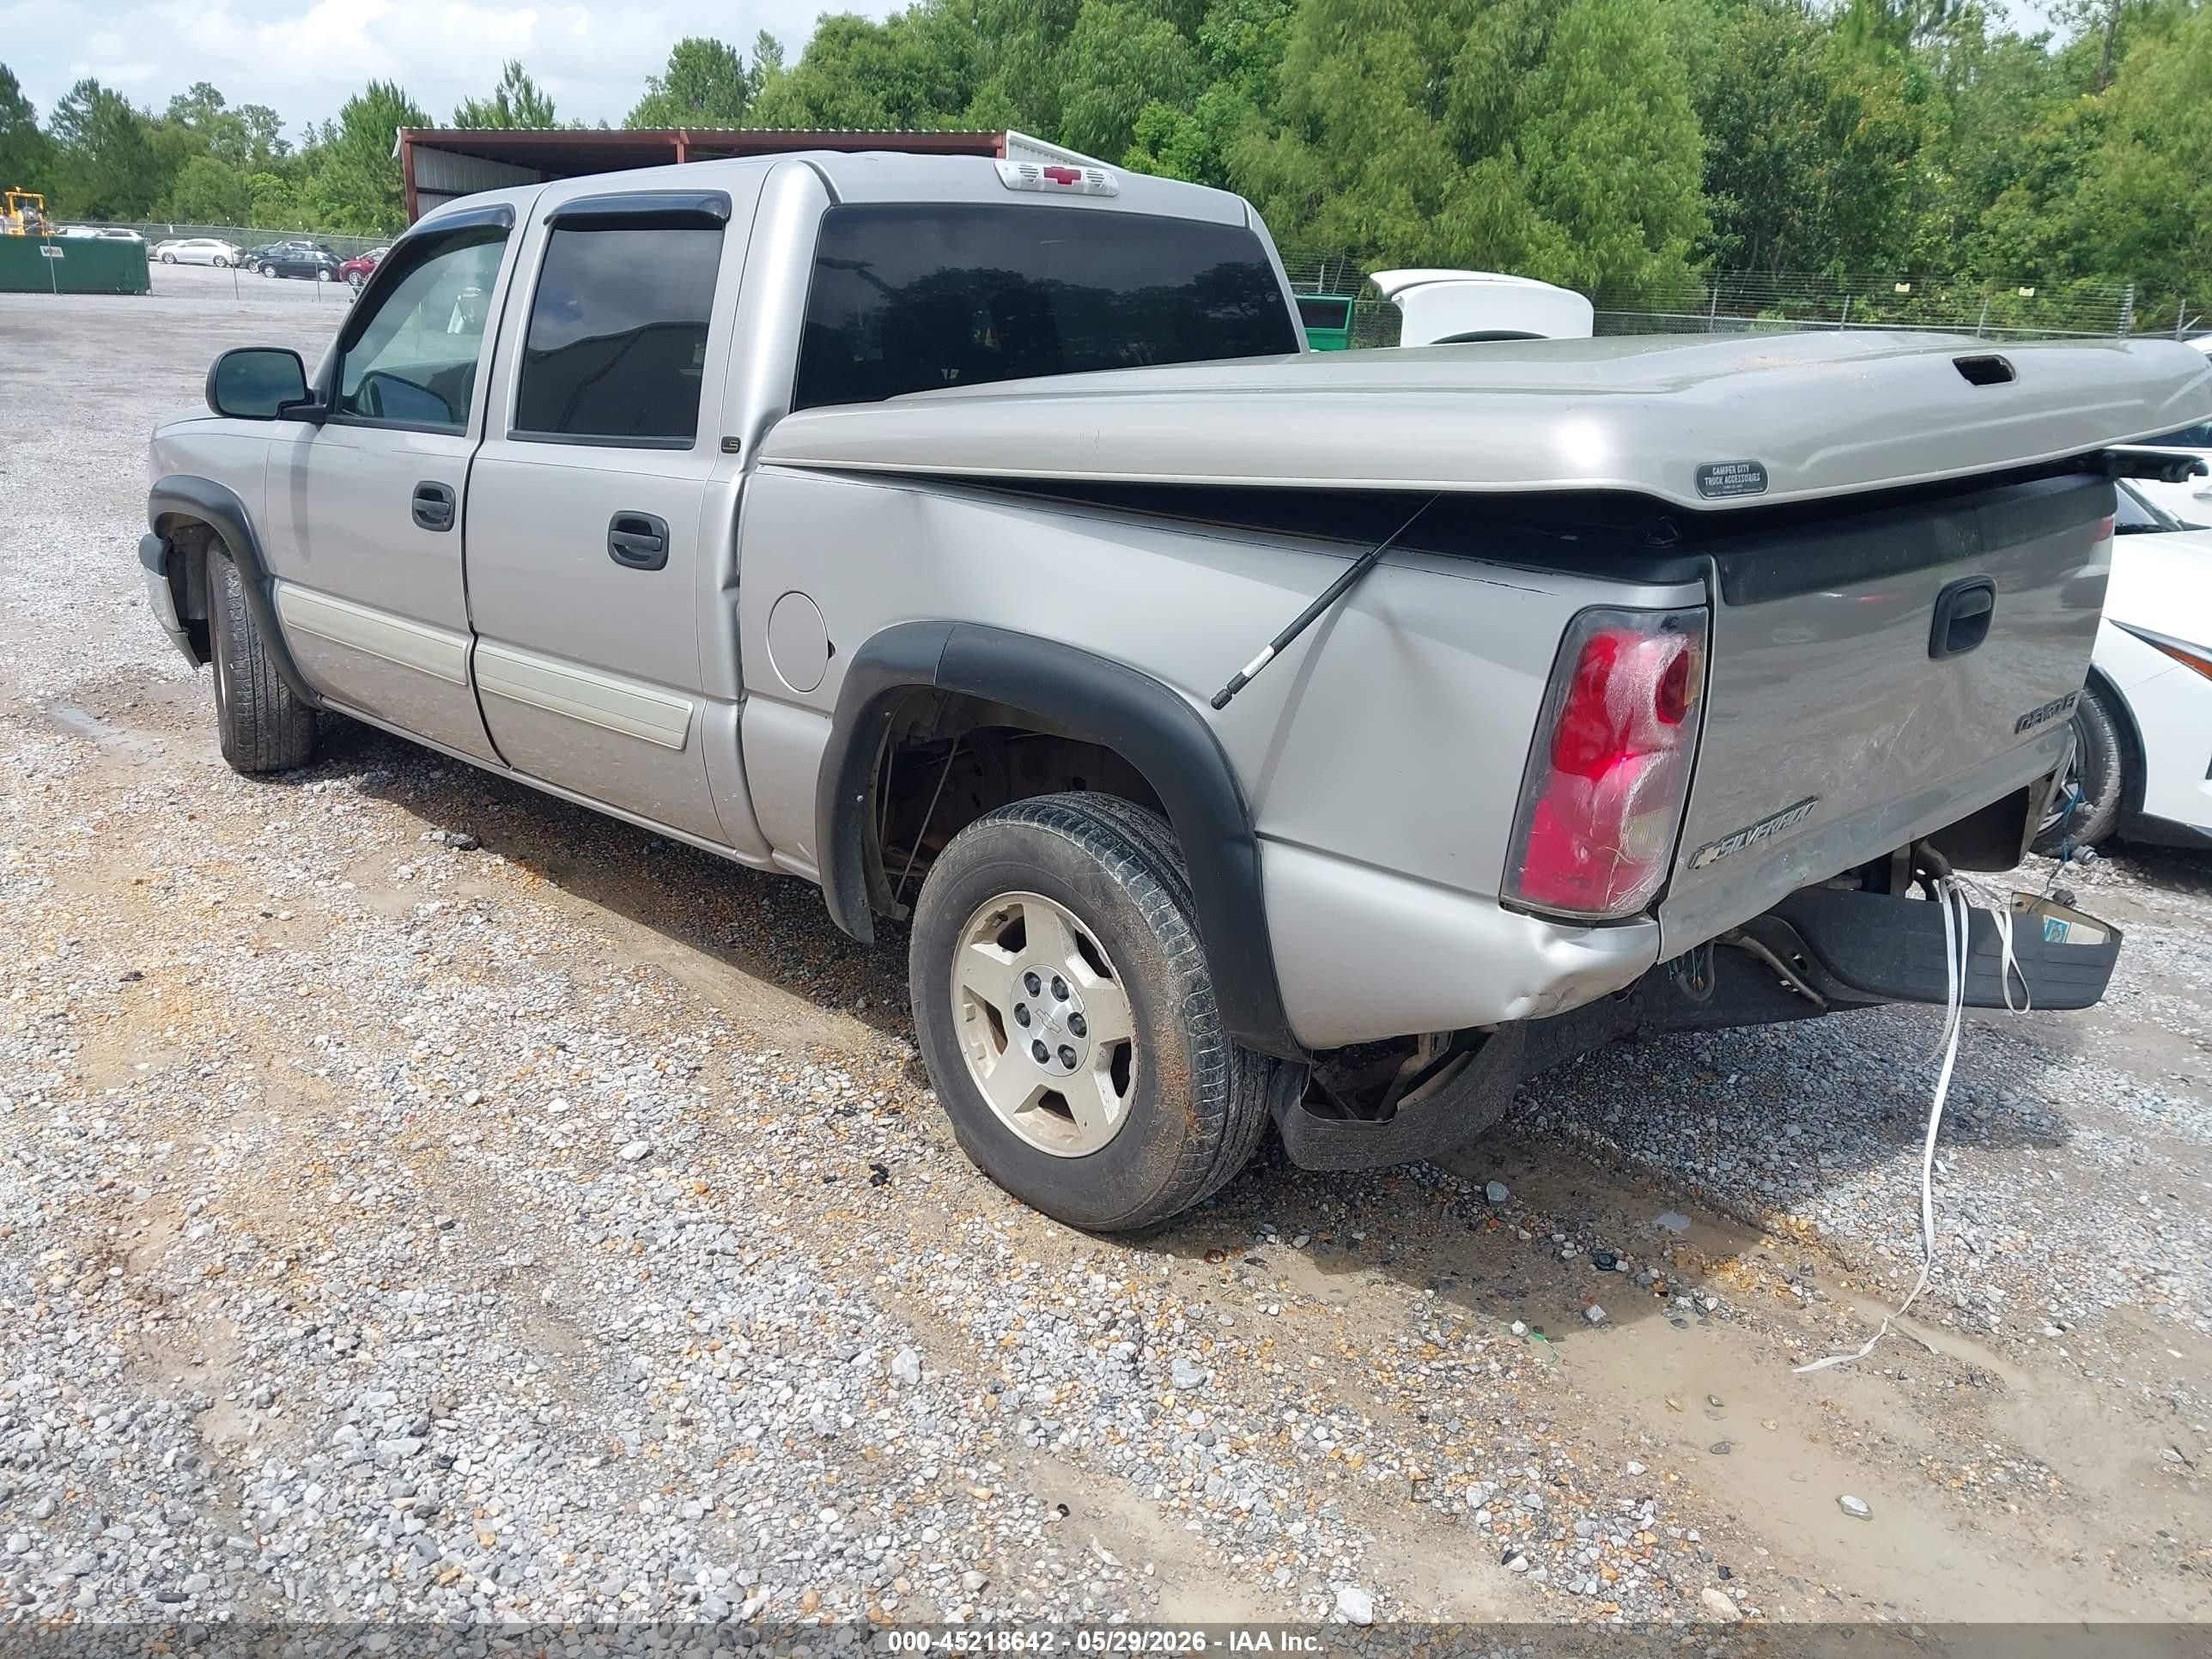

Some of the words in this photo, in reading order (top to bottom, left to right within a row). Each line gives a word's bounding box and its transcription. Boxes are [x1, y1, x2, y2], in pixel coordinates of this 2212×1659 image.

[722, 439, 739, 451] LS
[1712, 465, 1737, 476] CAMPER
[1737, 464, 1750, 474] CITY
[1705, 476, 1723, 486] TRUCK
[1723, 472, 1761, 484] ACCESSORIES
[1717, 799, 1818, 861] SILVERADO
